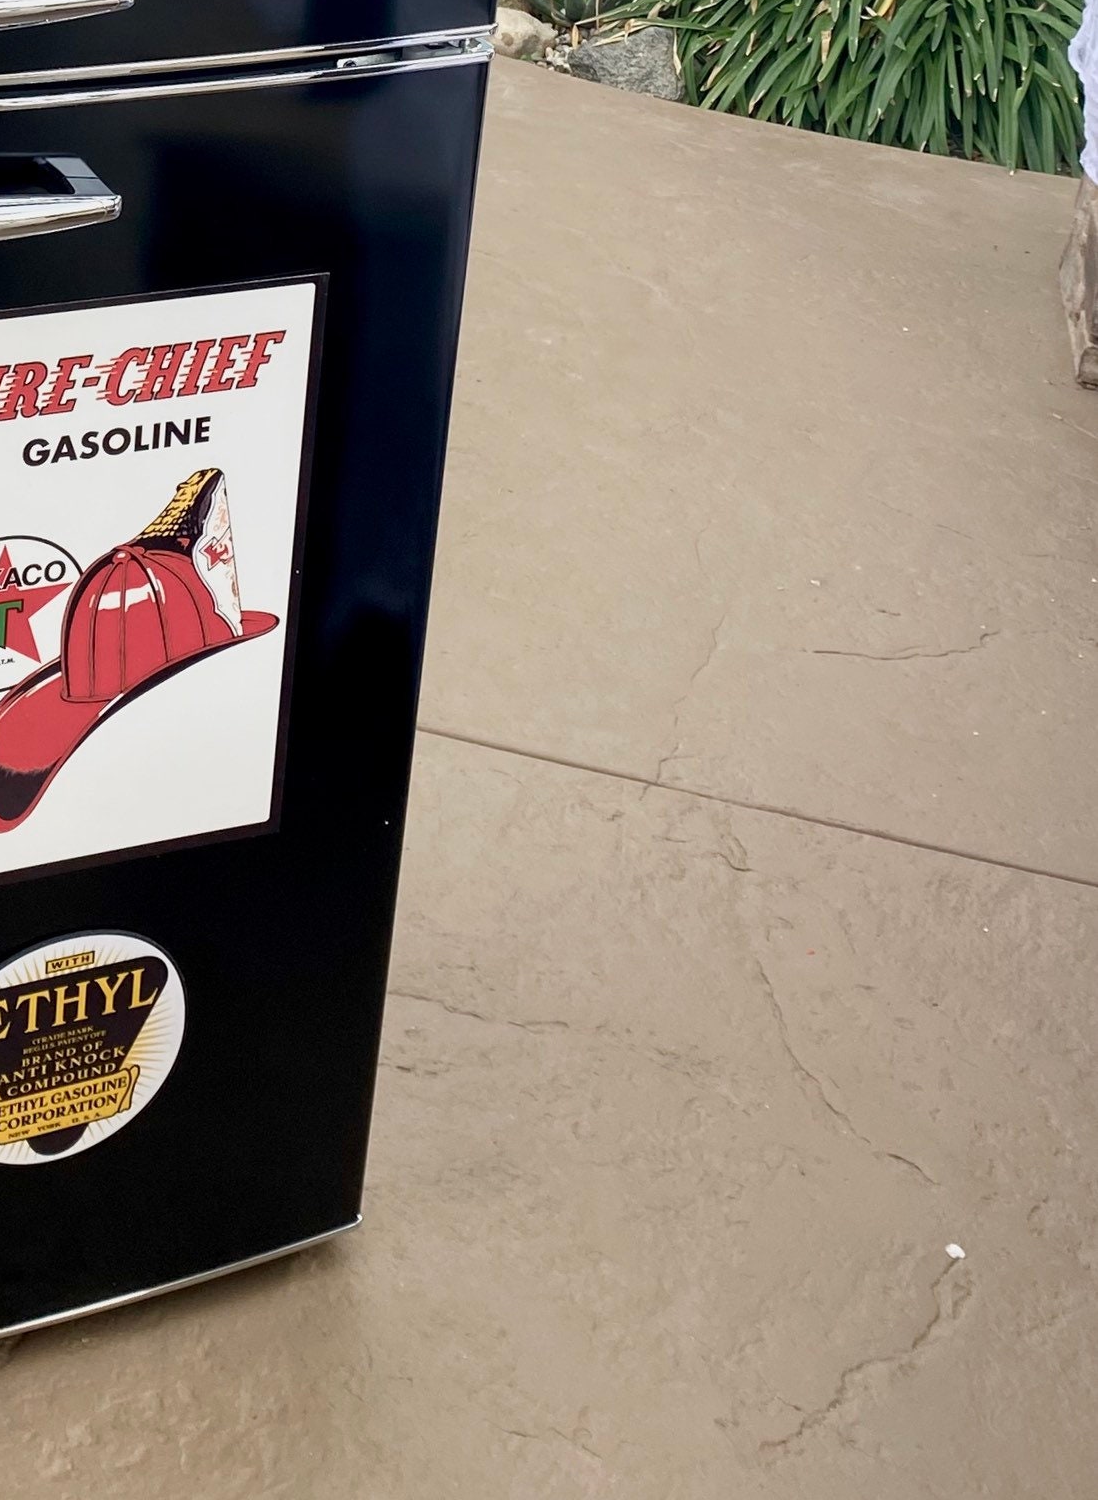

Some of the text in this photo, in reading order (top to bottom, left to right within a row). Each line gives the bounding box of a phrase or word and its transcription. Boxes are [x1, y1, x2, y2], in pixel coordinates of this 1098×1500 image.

[22, 416, 212, 467] GASOLINE
[51, 955, 91, 969] WITH
[21, 1041, 104, 1067] BRAND OF
[54, 1046, 126, 1072] KNOCK
[6, 1063, 117, 1097] COMPOUND
[50, 1075, 128, 1104] GASOLINE
[8, 1129, 31, 1140] NEW
[37, 1121, 62, 1132] YORK
